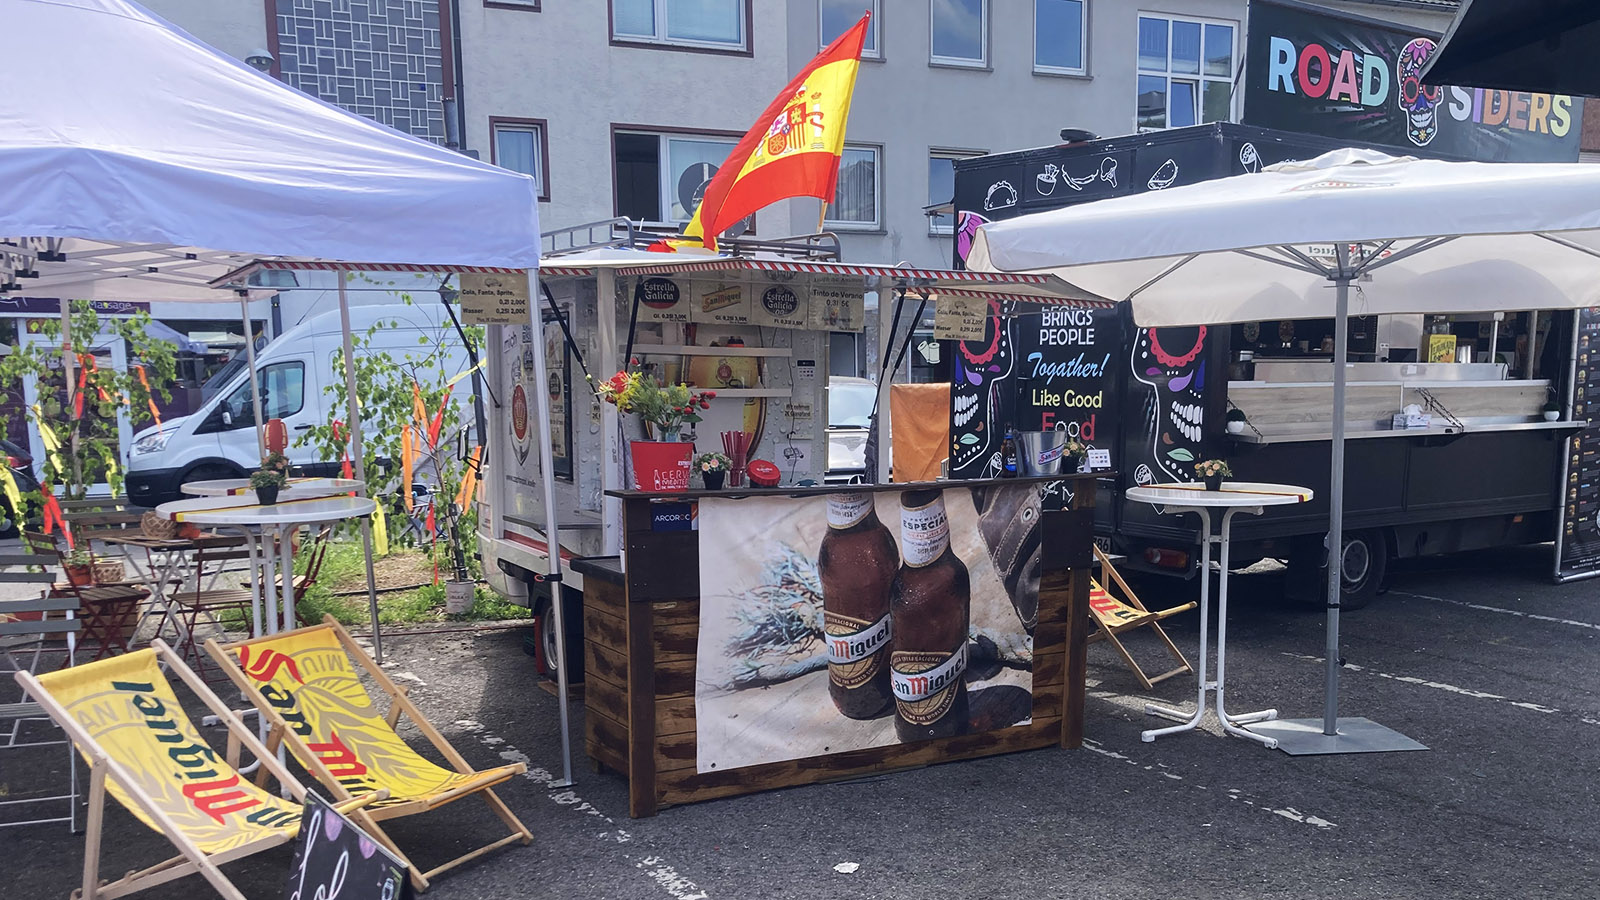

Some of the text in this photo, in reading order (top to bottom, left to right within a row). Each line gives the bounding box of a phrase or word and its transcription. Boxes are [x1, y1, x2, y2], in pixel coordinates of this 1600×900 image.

[1268, 36, 1572, 137] ROAD SIDERS
[643, 282, 675, 292] Estrella
[644, 291, 674, 301] Galicia
[766, 292, 795, 303] Estrella
[813, 289, 864, 300] Tinto de Verano
[767, 300, 793, 310] Galicia
[841, 300, 850, 308] 5€
[1041, 309, 1094, 327] BRINGS
[1039, 328, 1095, 346] PEOPLE
[1032, 388, 1103, 409] Like Good
[1042, 411, 1096, 441] Food
[661, 469, 690, 481] CERV
